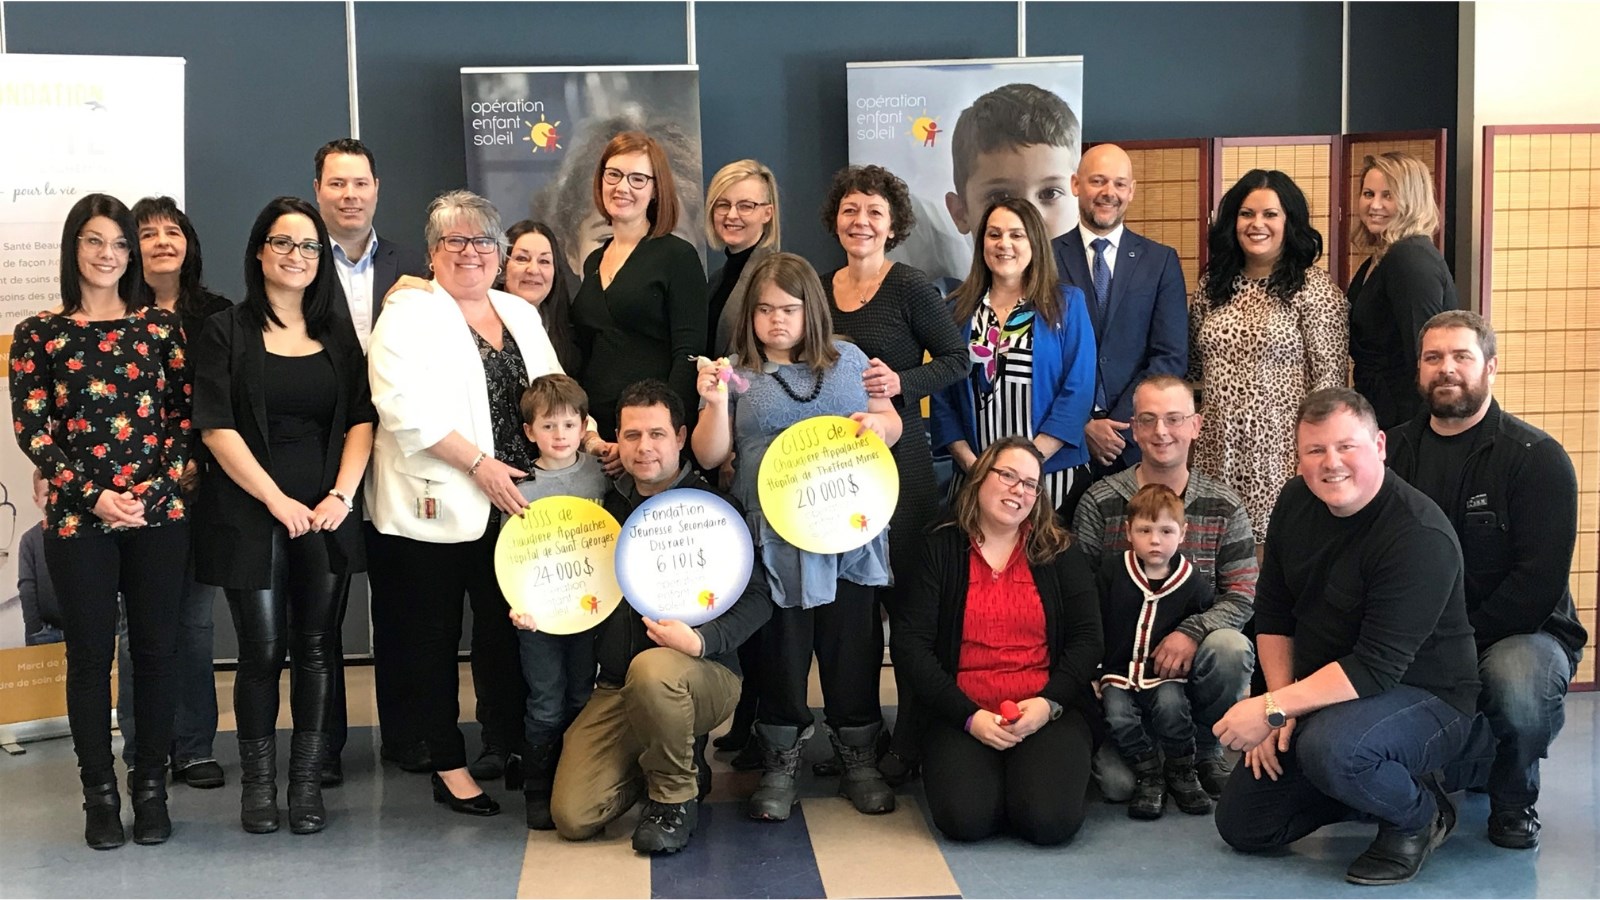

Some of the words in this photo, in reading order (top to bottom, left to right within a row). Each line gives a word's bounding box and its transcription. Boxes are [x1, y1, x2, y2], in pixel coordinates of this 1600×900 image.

[0, 81, 104, 107] NDATION
[856, 94, 927, 110] opération
[471, 98, 544, 116] opération
[472, 115, 520, 132] enfant
[857, 109, 902, 126] enfant
[473, 129, 514, 146] soleil
[856, 126, 895, 140] soleil
[13, 186, 41, 203] pour
[44, 181, 57, 196] la
[60, 187, 77, 195] vie
[3, 242, 32, 251] Santé
[3, 259, 16, 268] de
[19, 258, 46, 268] façon
[10, 276, 23, 284] de
[25, 275, 51, 284] soins
[28, 292, 45, 300] des
[827, 424, 847, 441] de
[822, 437, 870, 461] Appalaches
[802, 470, 812, 481] de
[817, 458, 854, 476] Thetford
[796, 485, 816, 509] 20
[558, 508, 573, 522] de
[643, 503, 705, 522] Fondation
[557, 519, 606, 541] Appalaches
[630, 525, 672, 539] Jeunesse
[679, 518, 727, 533] Secondaire
[543, 547, 552, 558] de
[556, 540, 577, 555] Saint
[581, 533, 614, 549] Georges
[650, 536, 694, 552] Disraeli
[656, 554, 667, 573] 6
[533, 565, 554, 587] 24
[17, 661, 44, 671] Merci
[47, 659, 59, 668] de
[17, 679, 29, 688] de
[32, 675, 53, 686] soin
[55, 673, 66, 682] de
